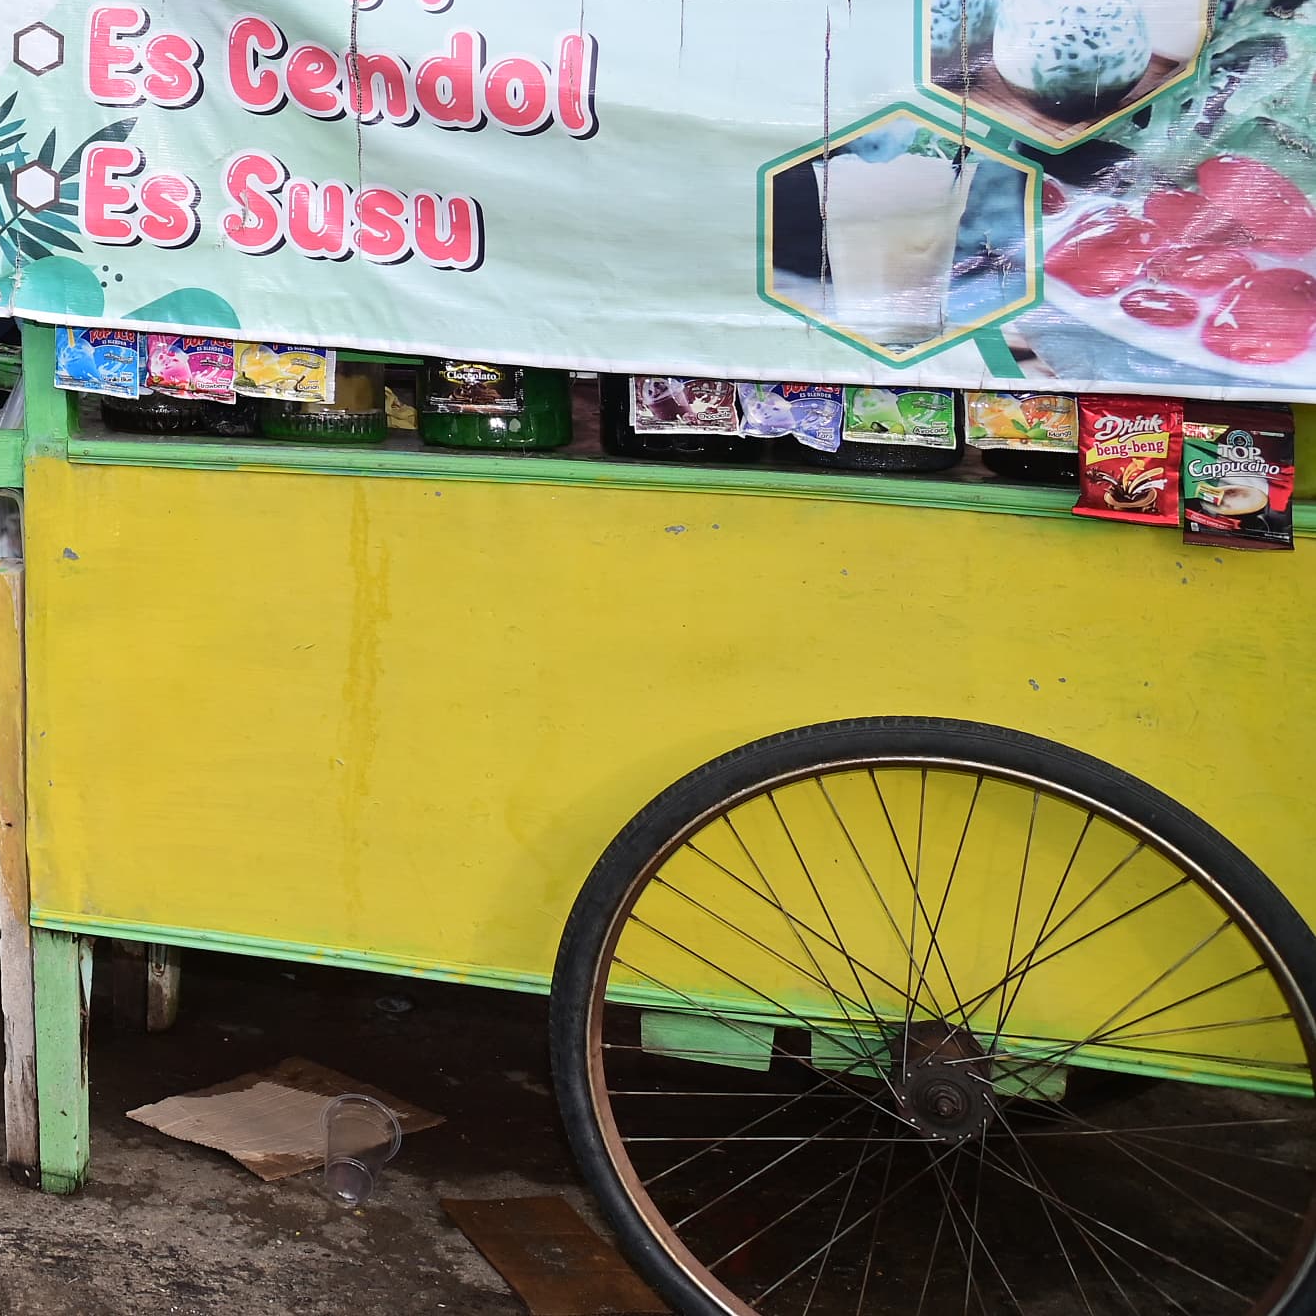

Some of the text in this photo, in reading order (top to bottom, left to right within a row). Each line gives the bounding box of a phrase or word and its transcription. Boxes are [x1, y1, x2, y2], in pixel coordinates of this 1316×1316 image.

[83, 3, 598, 139] Es Cendol
[79, 141, 485, 272] Es Susu
[1094, 413, 1164, 443] Drink
[1094, 440, 1165, 458] beng-beng
[1188, 459, 1280, 477] Cappuccino
